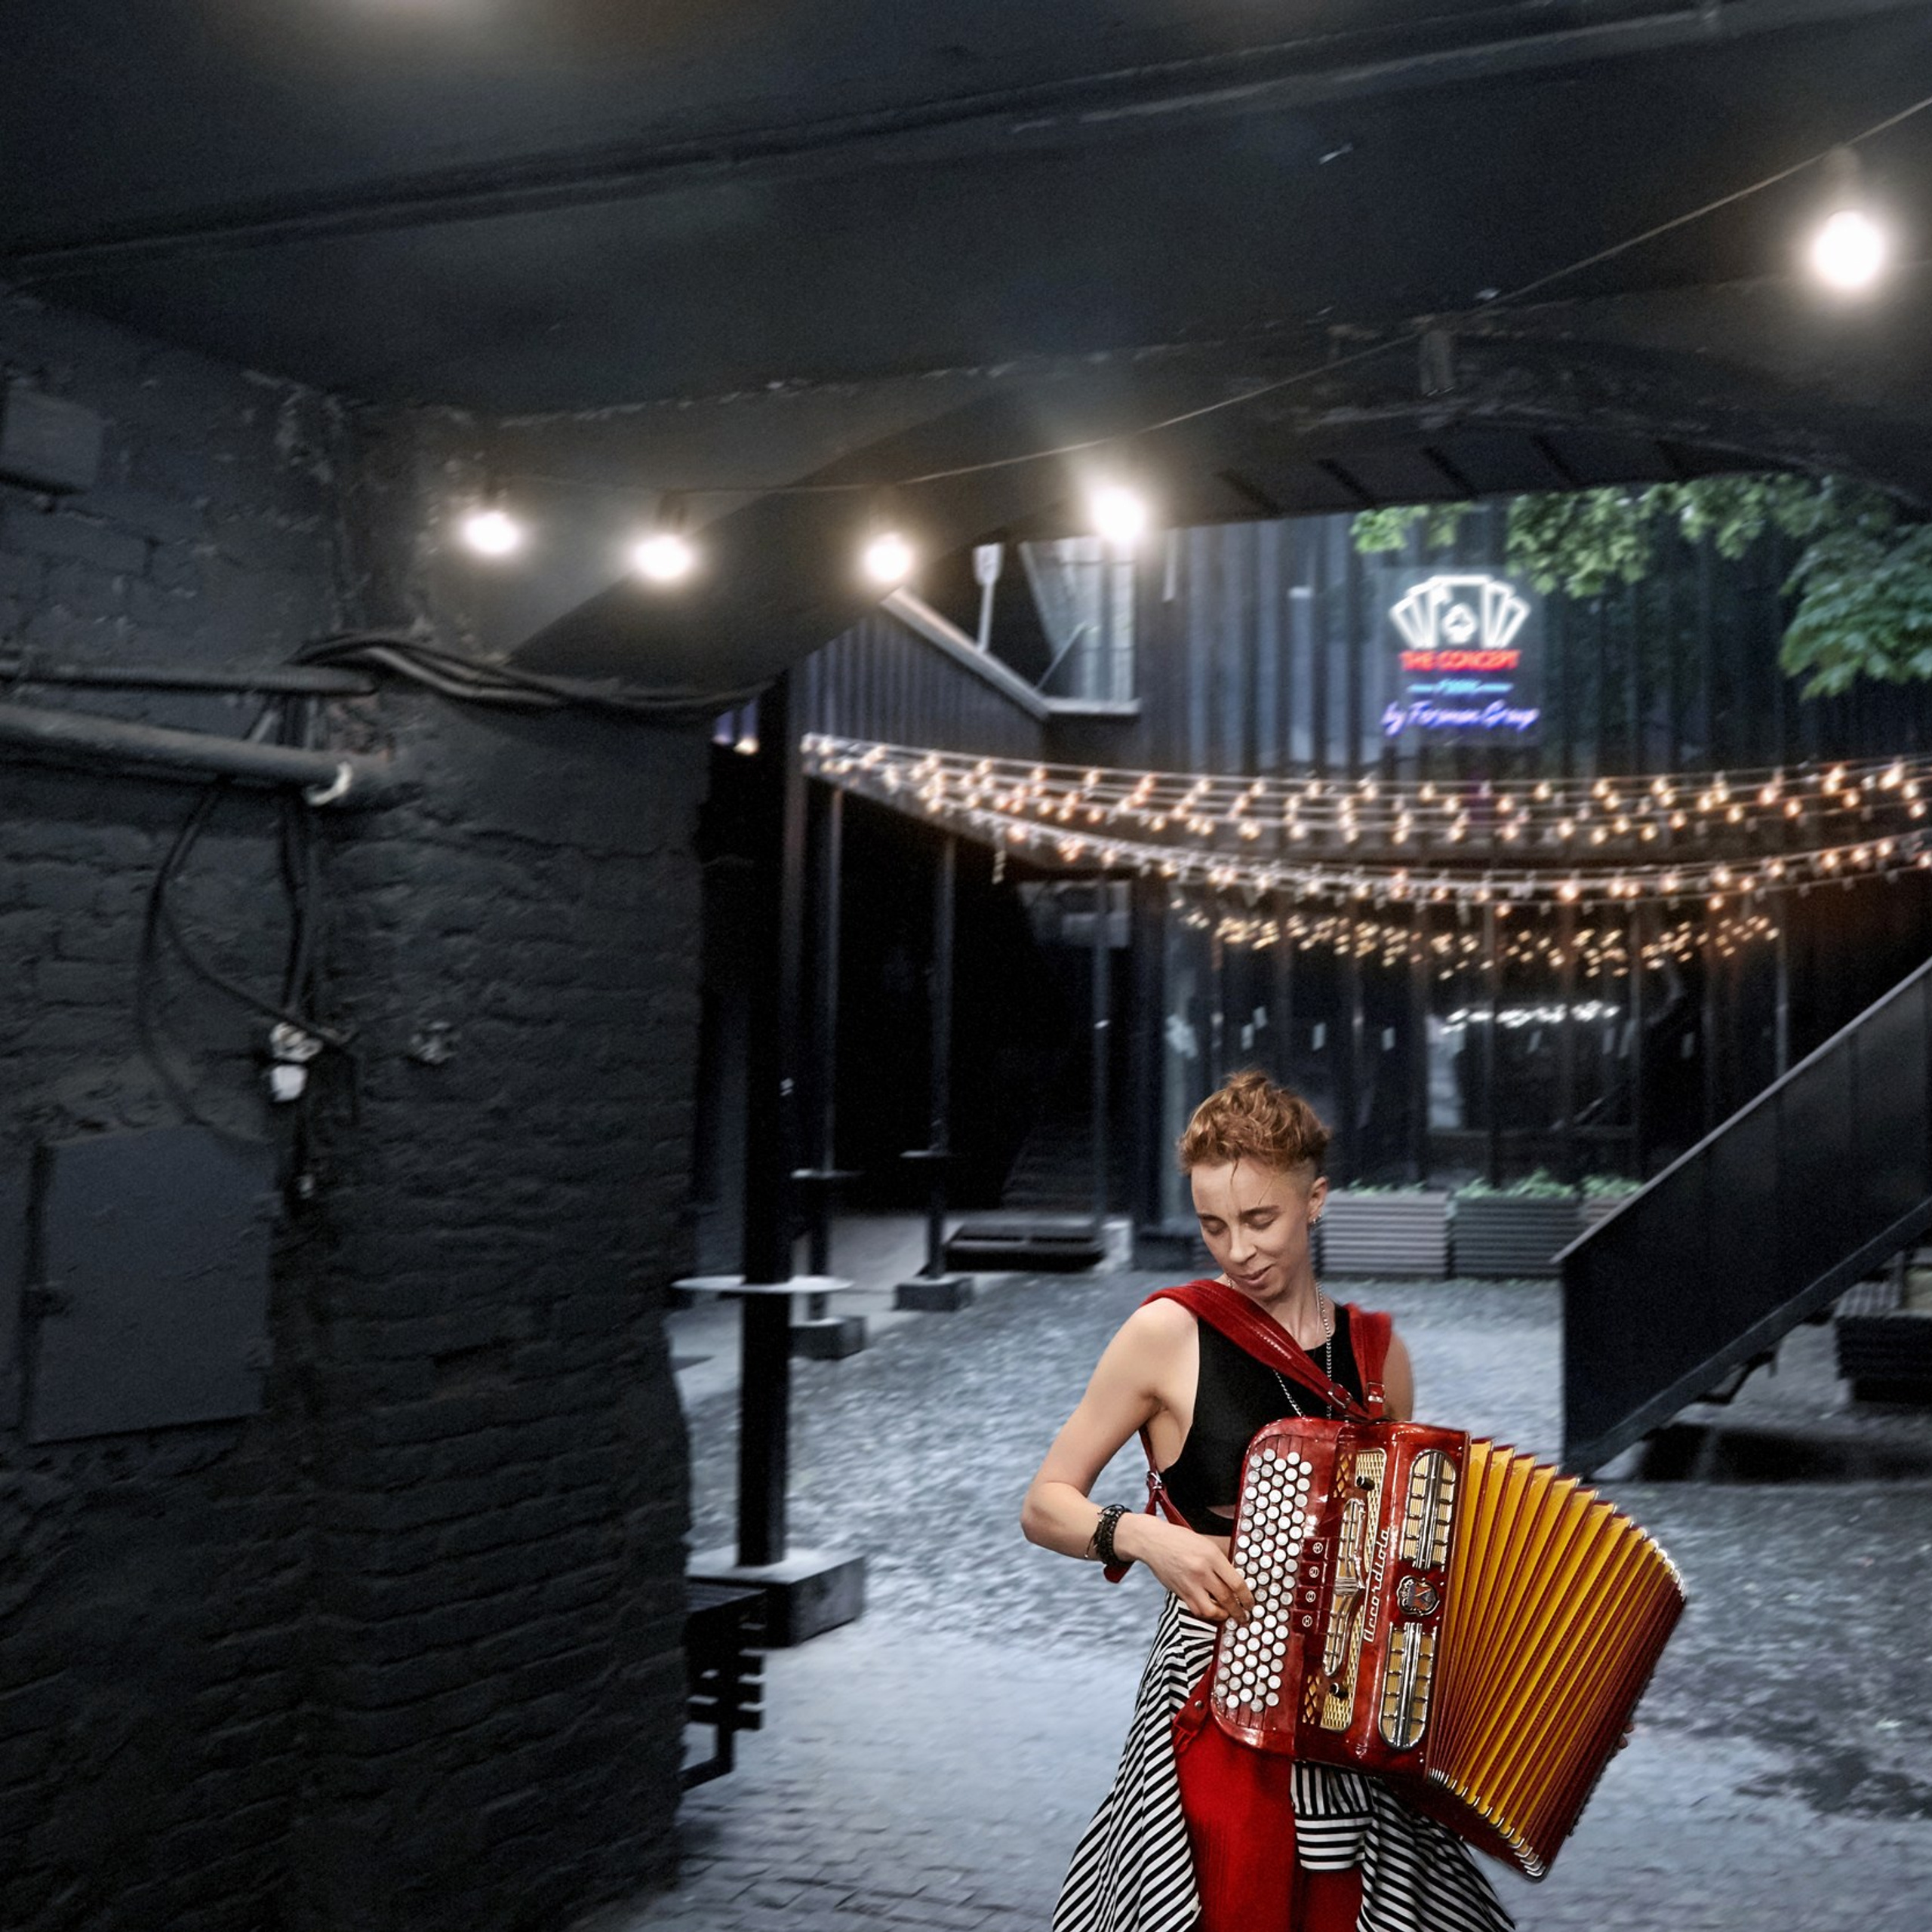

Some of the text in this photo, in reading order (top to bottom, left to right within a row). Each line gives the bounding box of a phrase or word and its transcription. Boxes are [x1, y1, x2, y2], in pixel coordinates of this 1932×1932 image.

[1400, 649, 1521, 671] THE CONCEPT
[1381, 701, 1407, 736] by
[1364, 1526, 1390, 1642] Accordiola
